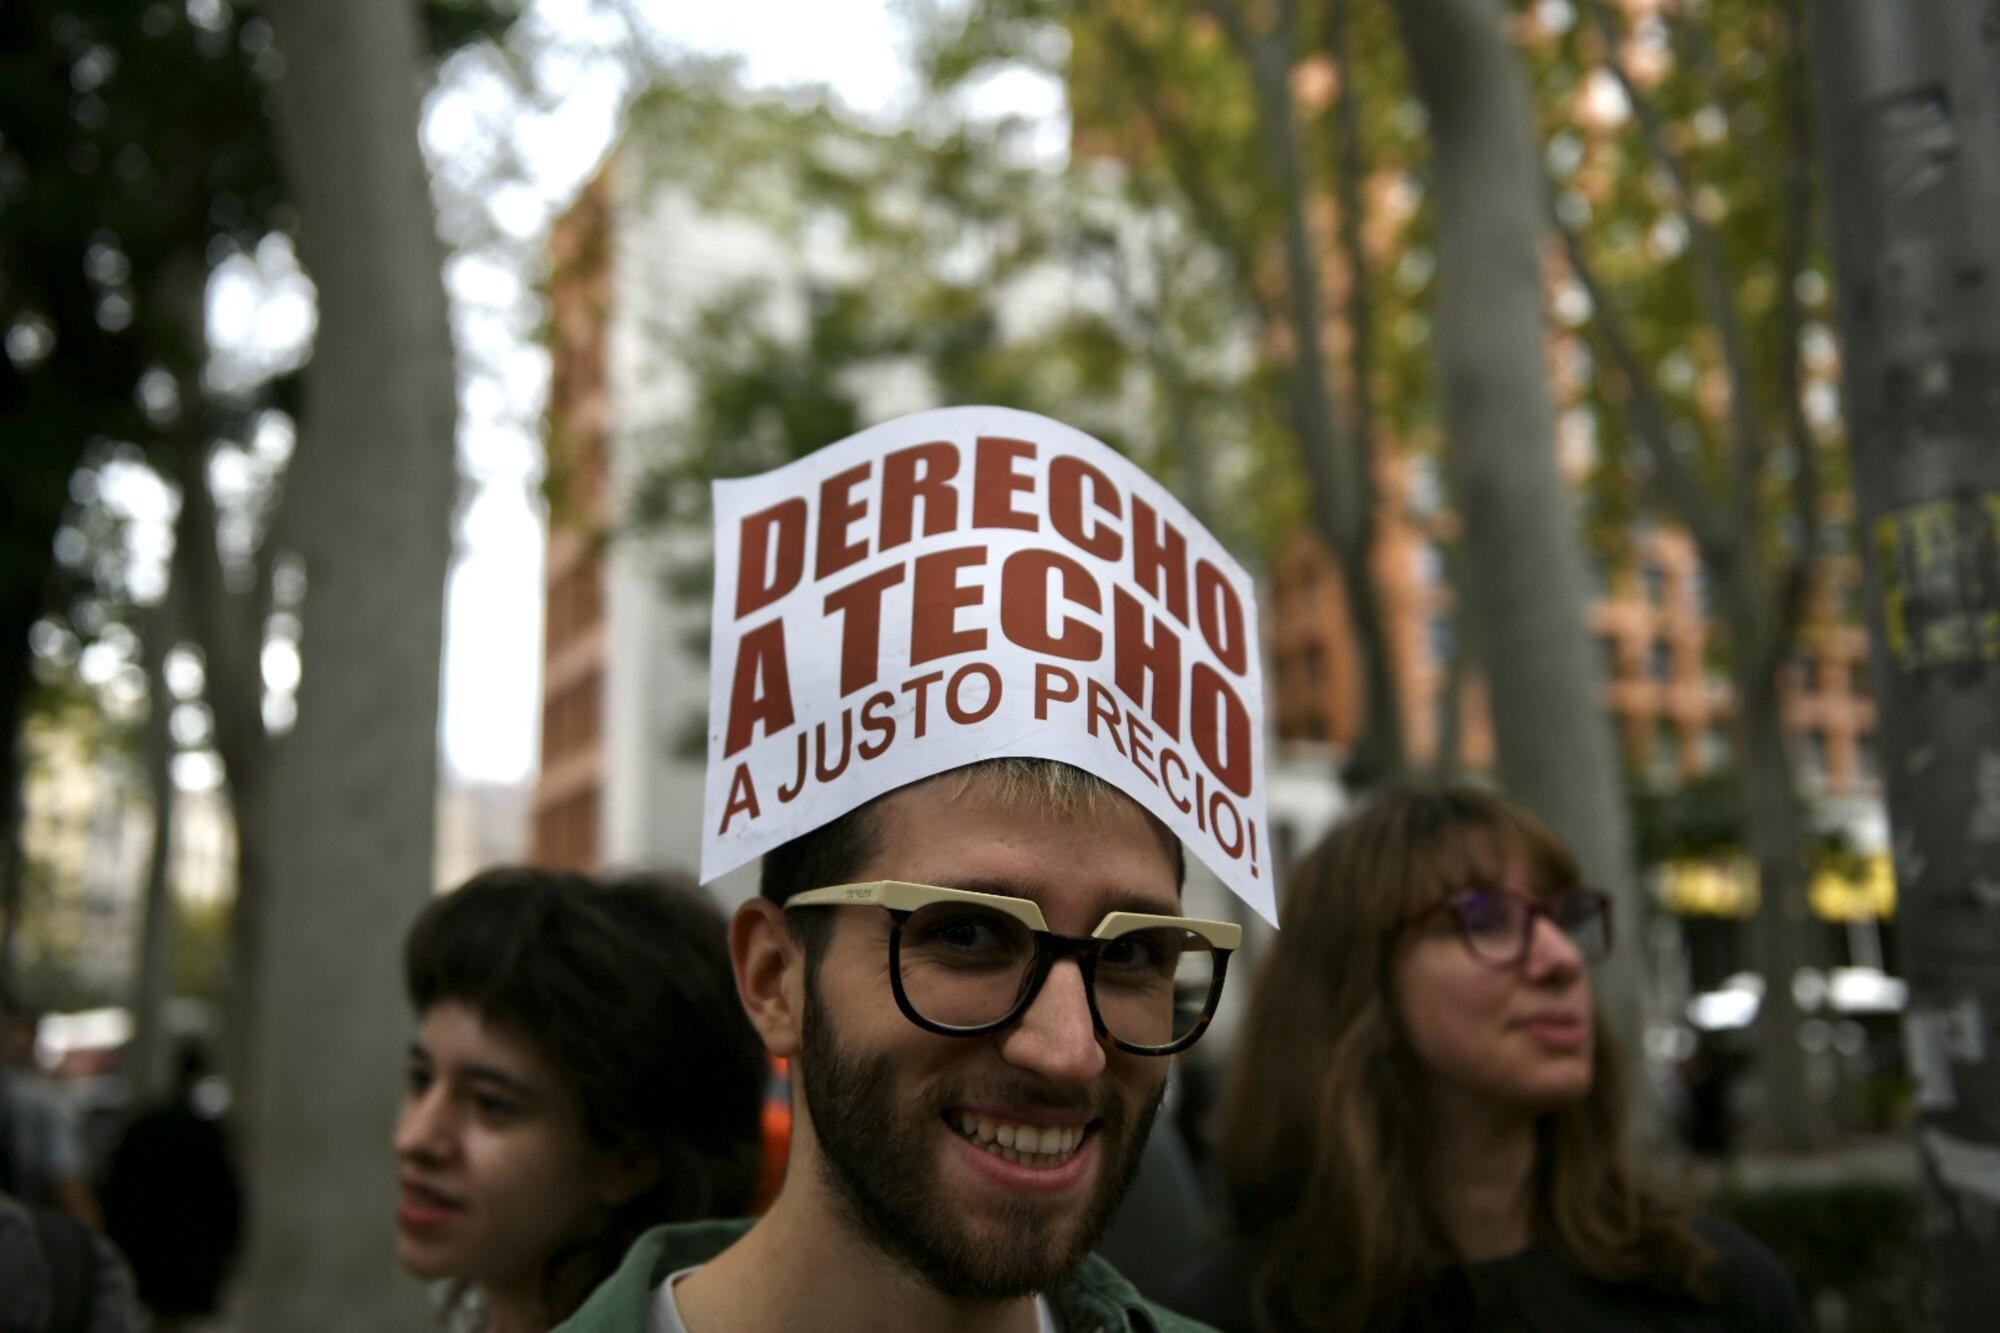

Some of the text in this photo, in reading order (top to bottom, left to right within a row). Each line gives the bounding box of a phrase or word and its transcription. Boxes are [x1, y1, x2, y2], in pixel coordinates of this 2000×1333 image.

[723, 545, 1252, 798] A TECHO
[734, 435, 1247, 677] DERECHO
[718, 662, 1259, 878] A JUSTO PRECIO!
